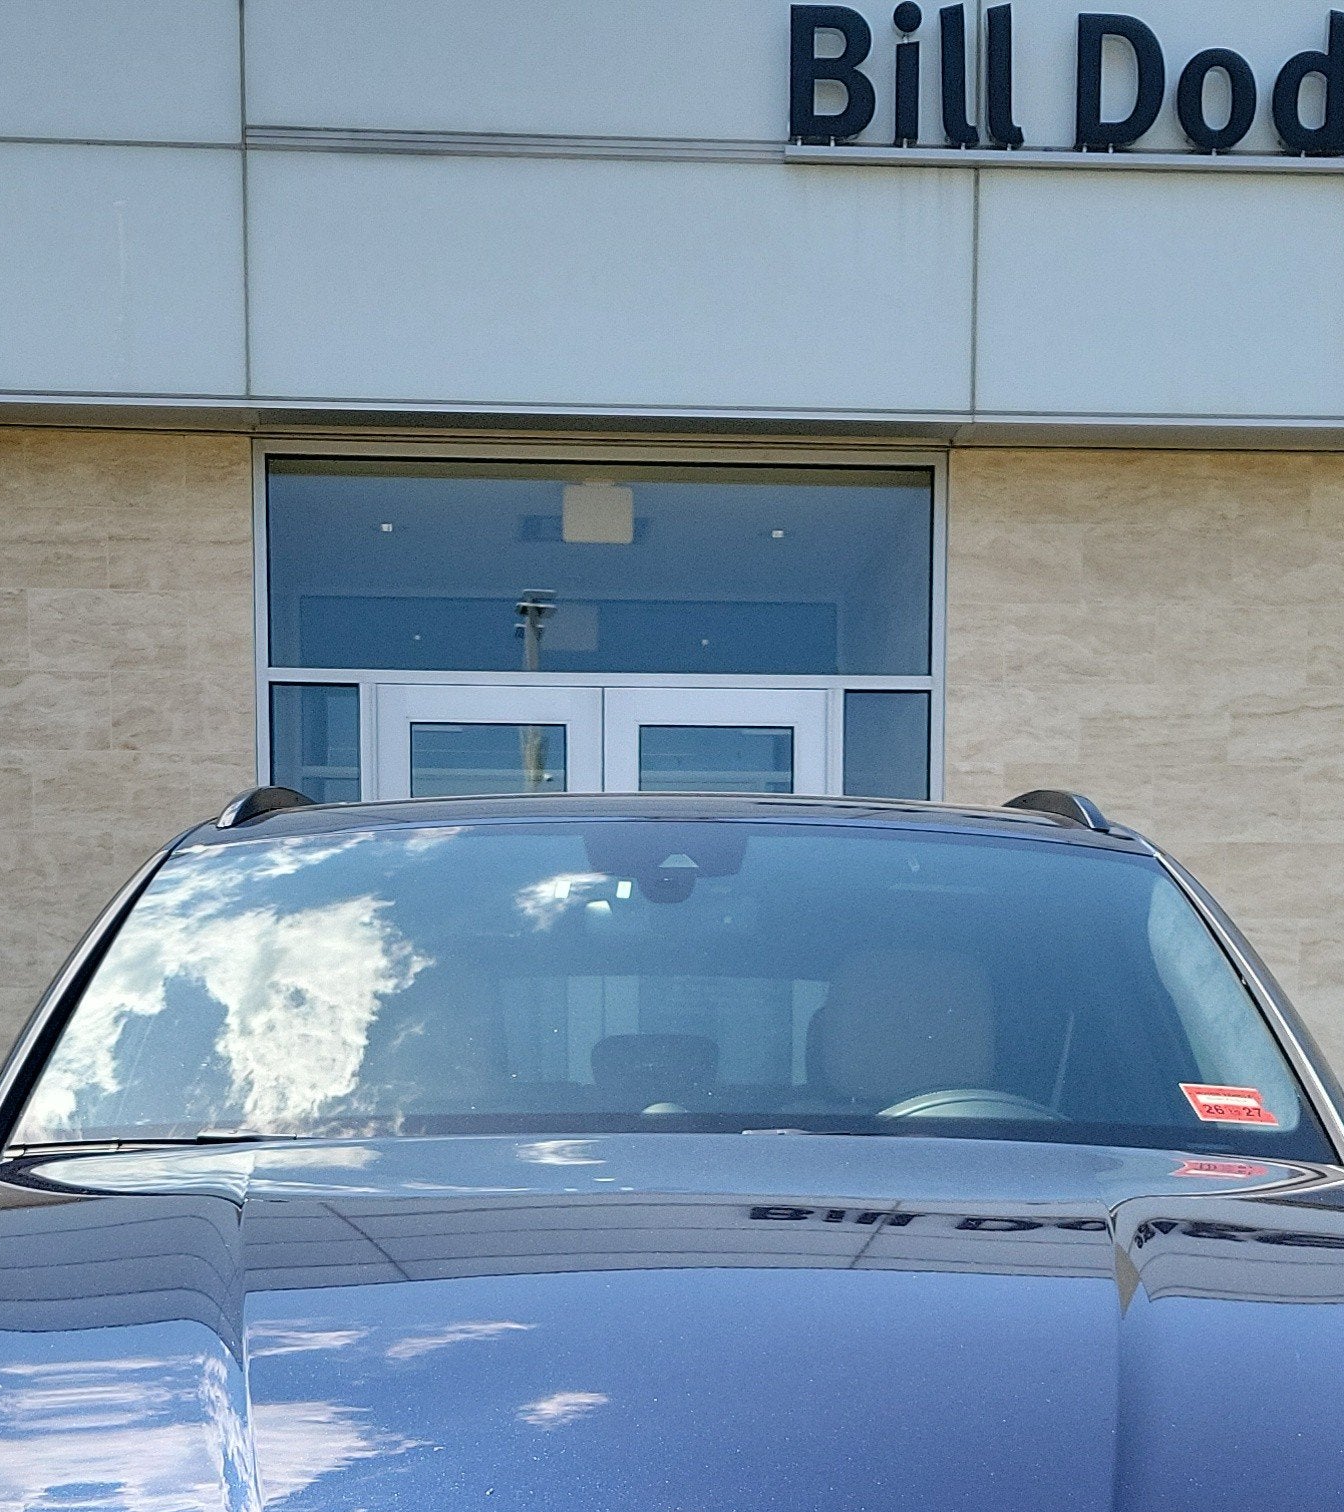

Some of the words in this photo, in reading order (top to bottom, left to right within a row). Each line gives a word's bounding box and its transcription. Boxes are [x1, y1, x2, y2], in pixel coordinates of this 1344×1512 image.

[789, 1, 1025, 146] Bill
[1203, 1104, 1225, 1115] 26
[1242, 1106, 1262, 1117] 27
